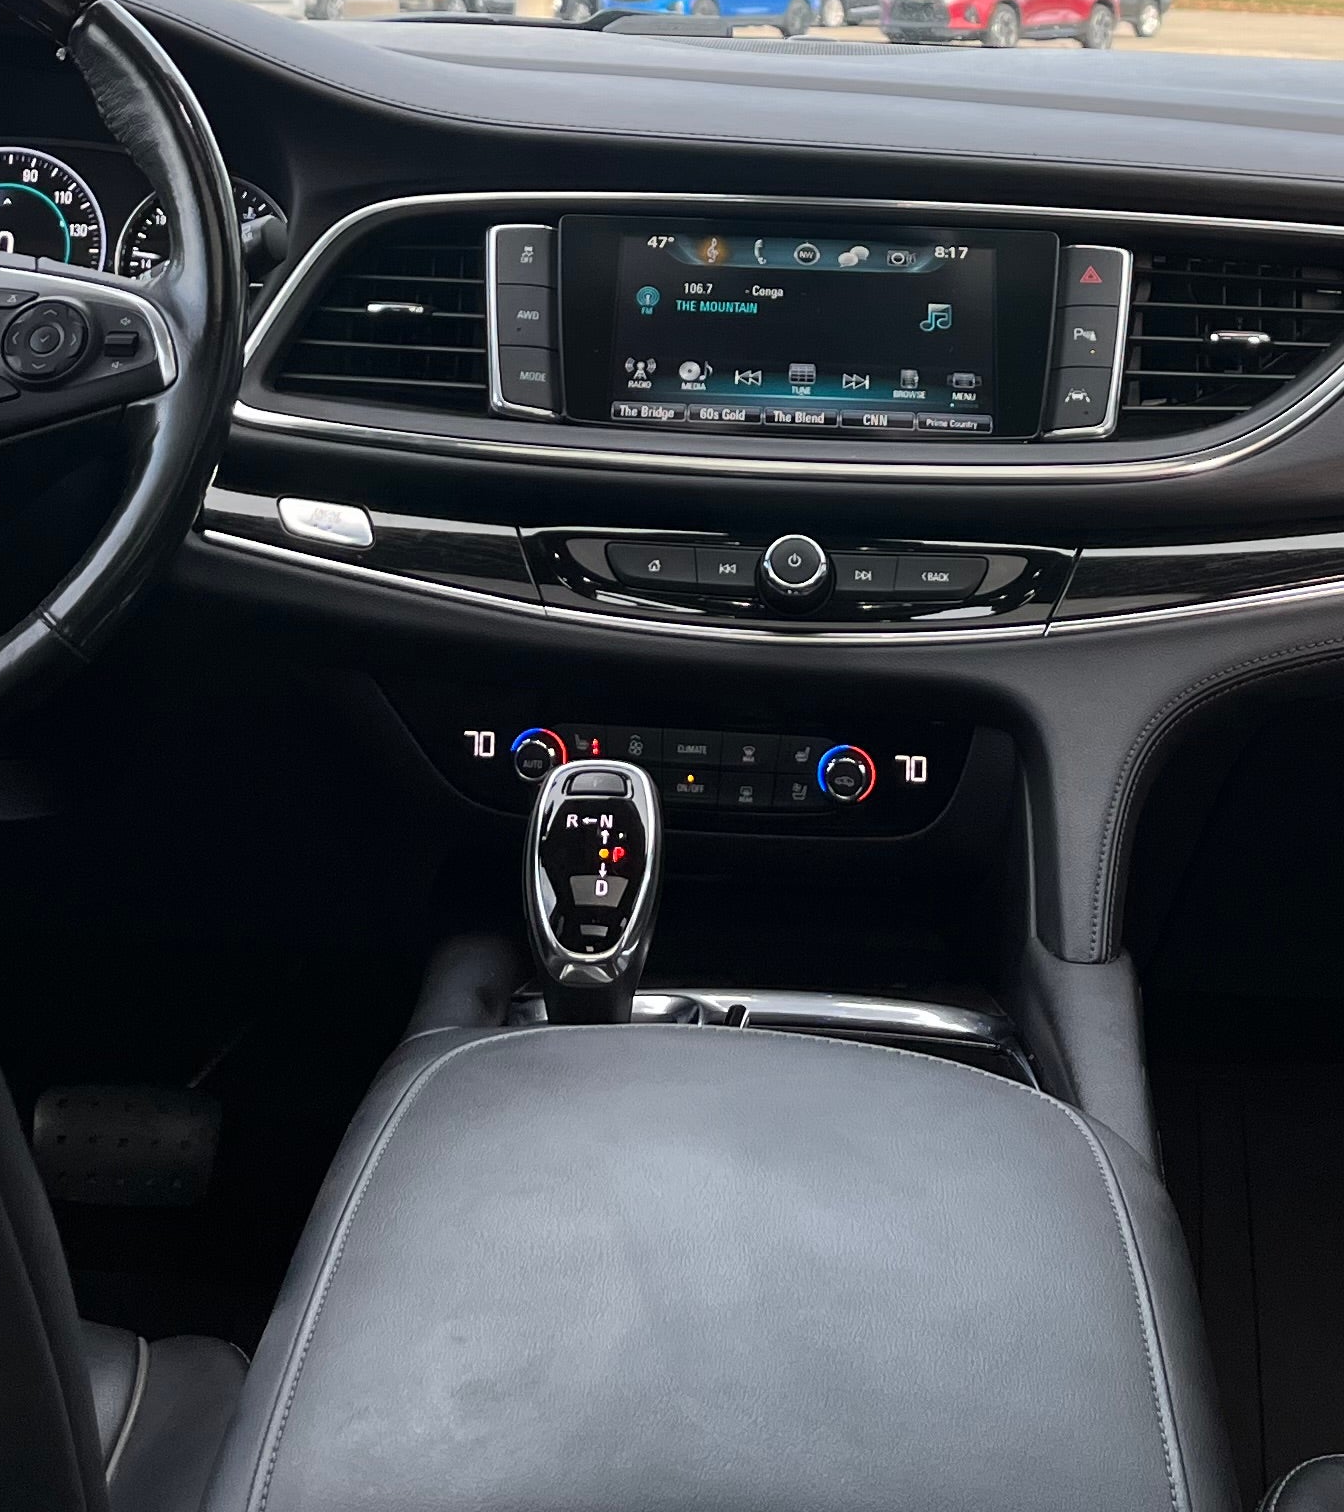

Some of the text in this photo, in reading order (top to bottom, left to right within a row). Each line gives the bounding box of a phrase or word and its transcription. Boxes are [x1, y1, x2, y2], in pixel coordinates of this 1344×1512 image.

[54, 190, 73, 205] 110
[69, 223, 88, 237] 130
[934, 245, 969, 259] 8:17
[684, 282, 713, 295] 106.7
[752, 284, 784, 300] Conga
[676, 299, 758, 314] THE MOUNTAIN
[516, 310, 539, 320] AWD
[519, 370, 546, 382] MODE
[627, 380, 652, 389] RADIO
[681, 381, 706, 390] MEDIA
[951, 392, 976, 401] MENU
[620, 404, 675, 421] The Bridge
[700, 408, 746, 421] 60s Gold
[773, 410, 825, 424] The Blend
[863, 414, 888, 426] CNN
[925, 418, 978, 430] Prime Country
[463, 730, 496, 757] 70
[677, 744, 707, 755] CLIMATE
[522, 759, 544, 770] AUTO
[894, 754, 928, 783] 70
[566, 814, 613, 828] R N
[612, 846, 625, 863] P
[595, 879, 608, 896] D
